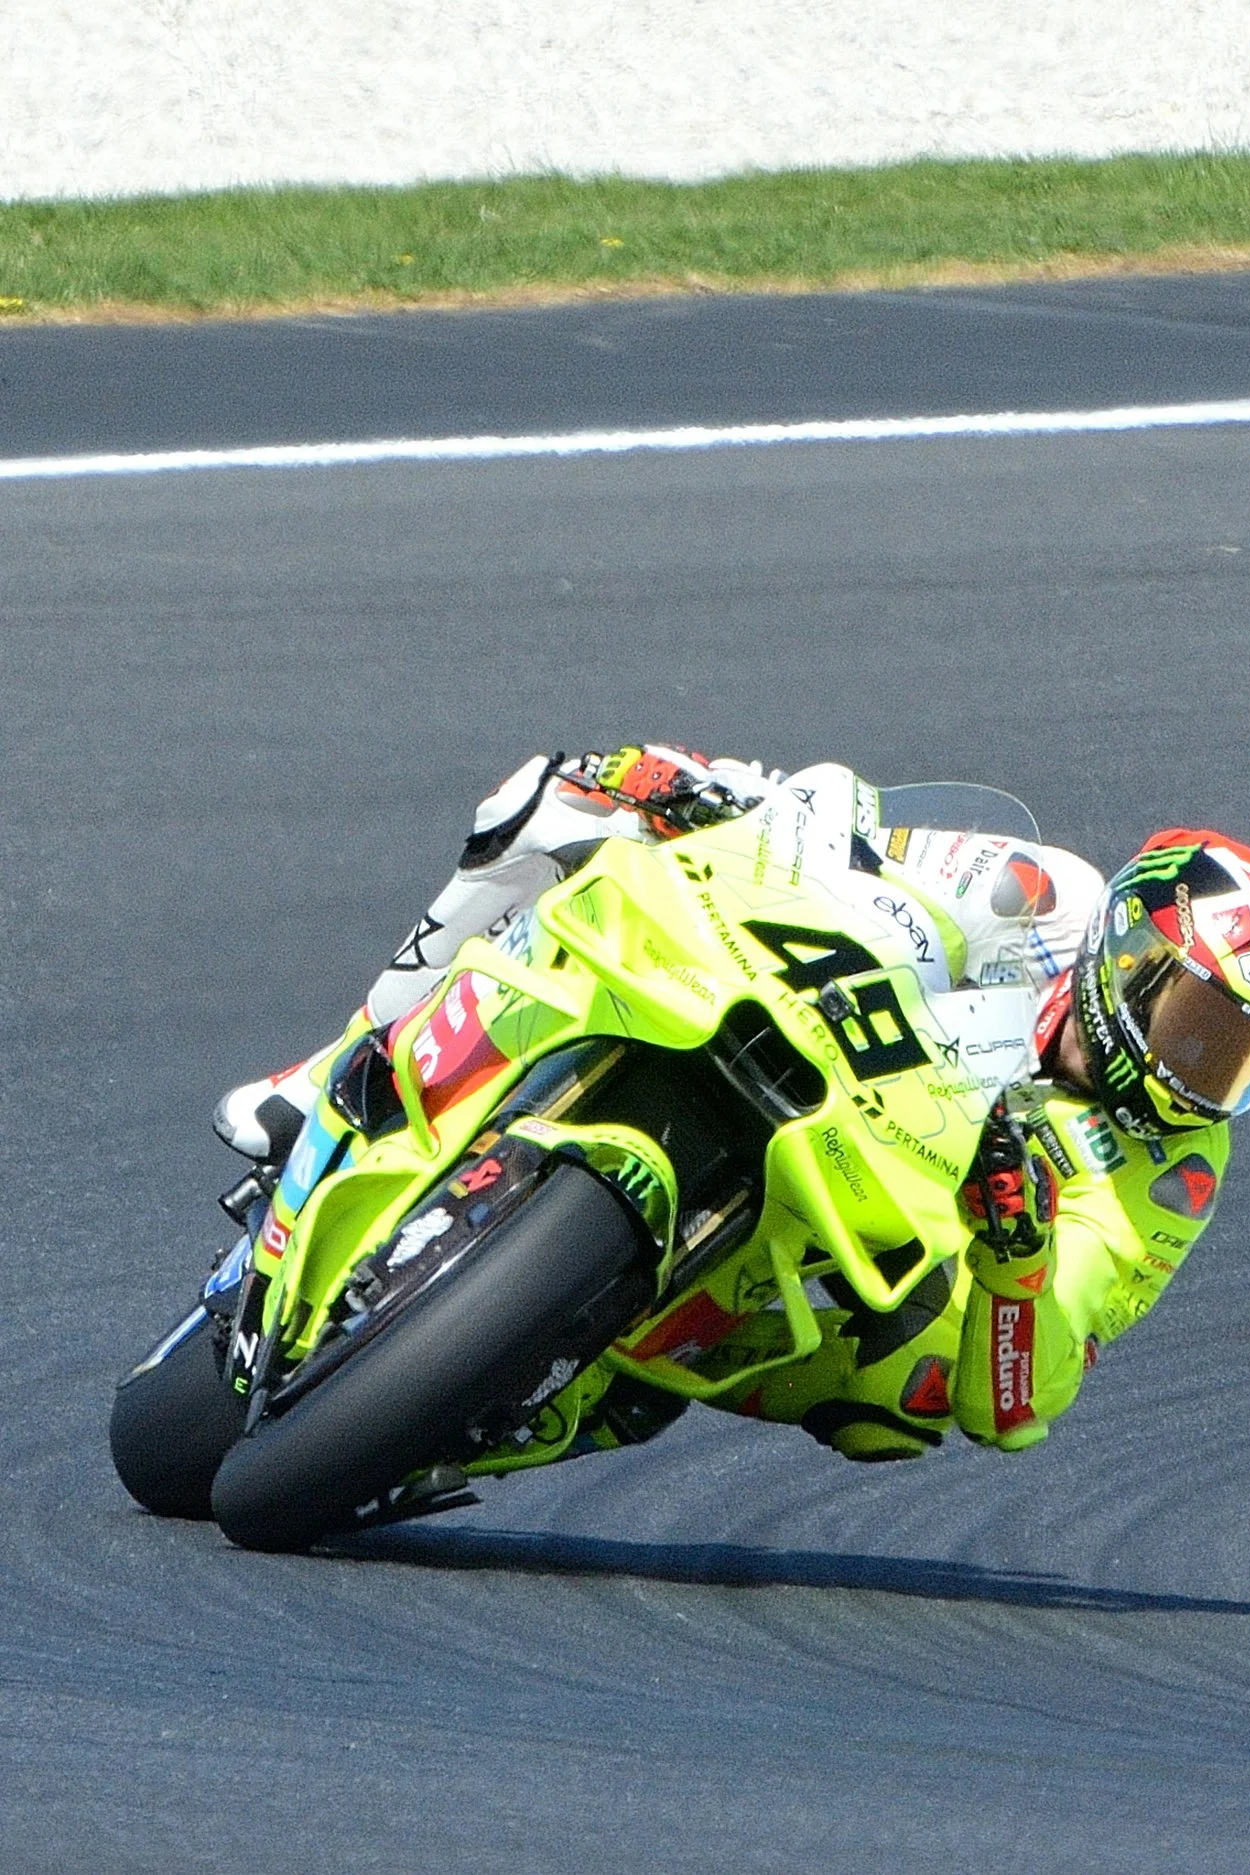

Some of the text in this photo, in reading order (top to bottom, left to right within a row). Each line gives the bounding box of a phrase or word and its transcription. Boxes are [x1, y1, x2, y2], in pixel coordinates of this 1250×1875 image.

[697, 891, 758, 982] PERTAMINA
[873, 896, 936, 964] ebay
[738, 919, 934, 1083] 49
[778, 991, 839, 1062] HERO
[965, 1037, 1025, 1057] CUPRA
[886, 1120, 960, 1183] PERTAMINA
[998, 1305, 1020, 1412] Enduro
